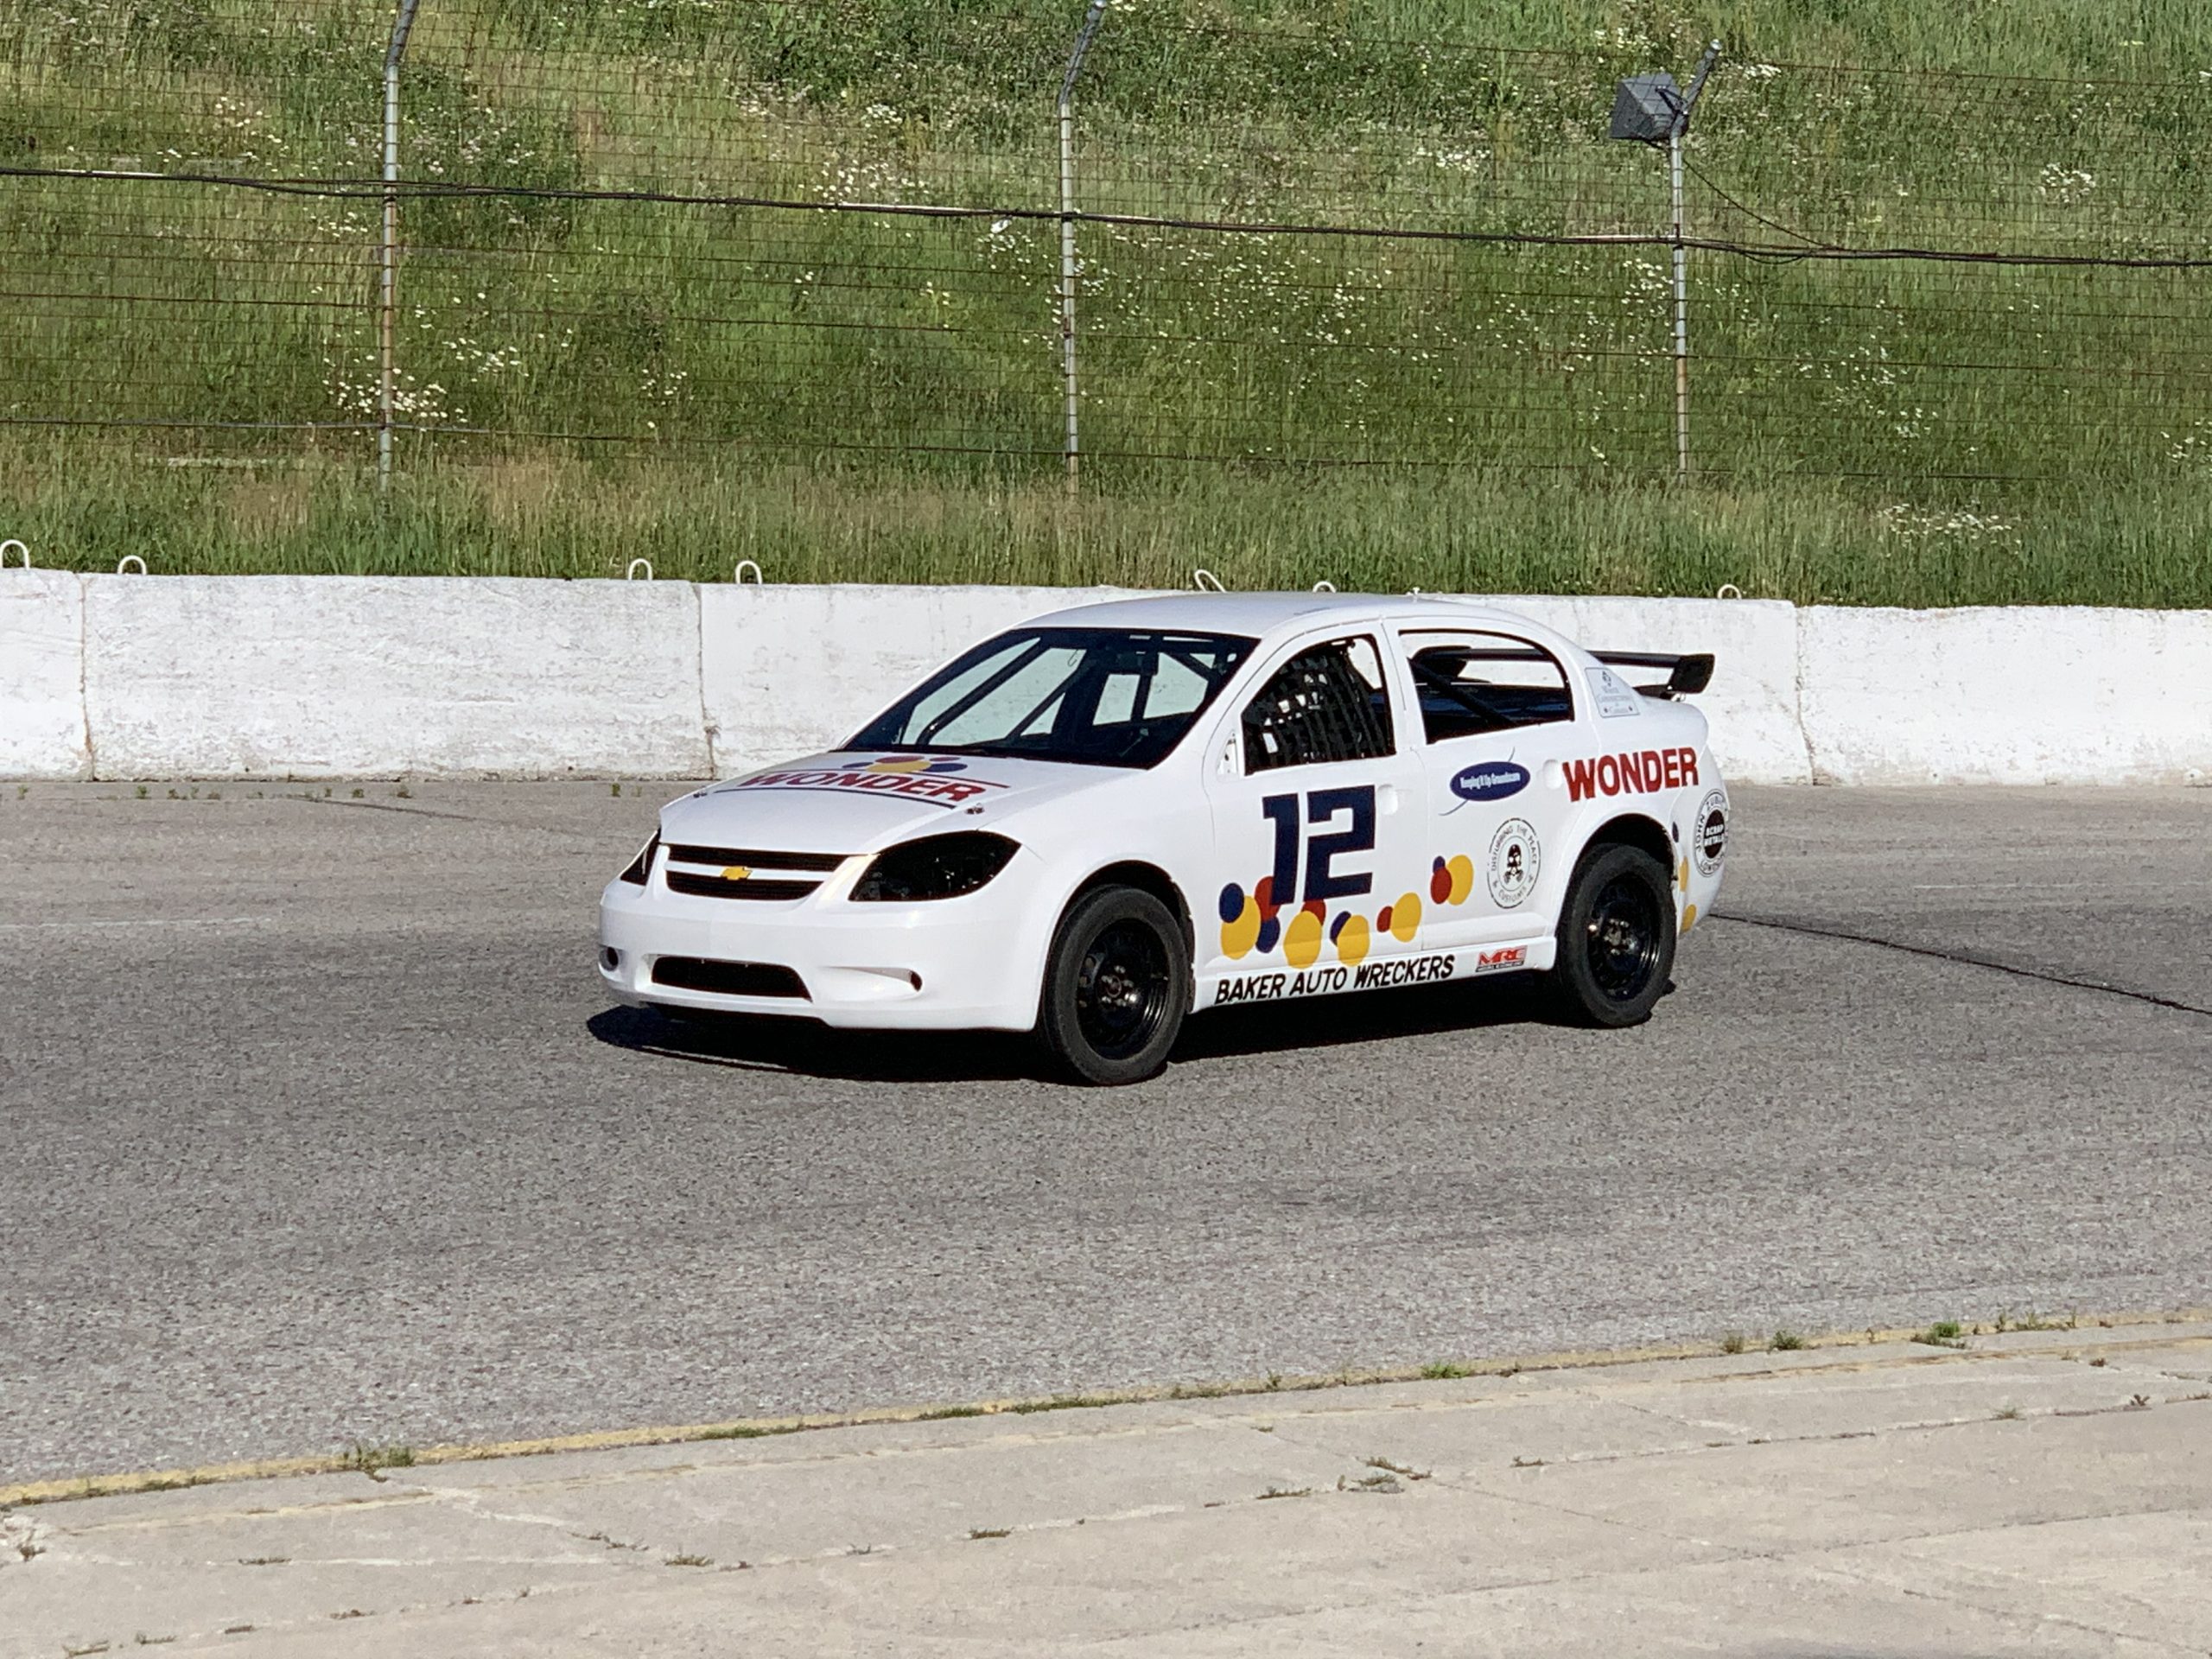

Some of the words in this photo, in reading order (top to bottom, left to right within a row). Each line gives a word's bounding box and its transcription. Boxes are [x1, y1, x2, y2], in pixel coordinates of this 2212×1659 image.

[737, 772, 986, 802] WONDER
[1561, 747, 1699, 802] WONDER
[1262, 785, 1376, 906] 12
[1516, 824, 1528, 836] THE
[1215, 974, 1286, 1004] BAKER
[1289, 968, 1347, 995] AUTO
[1353, 954, 1456, 988] WRECKERS
